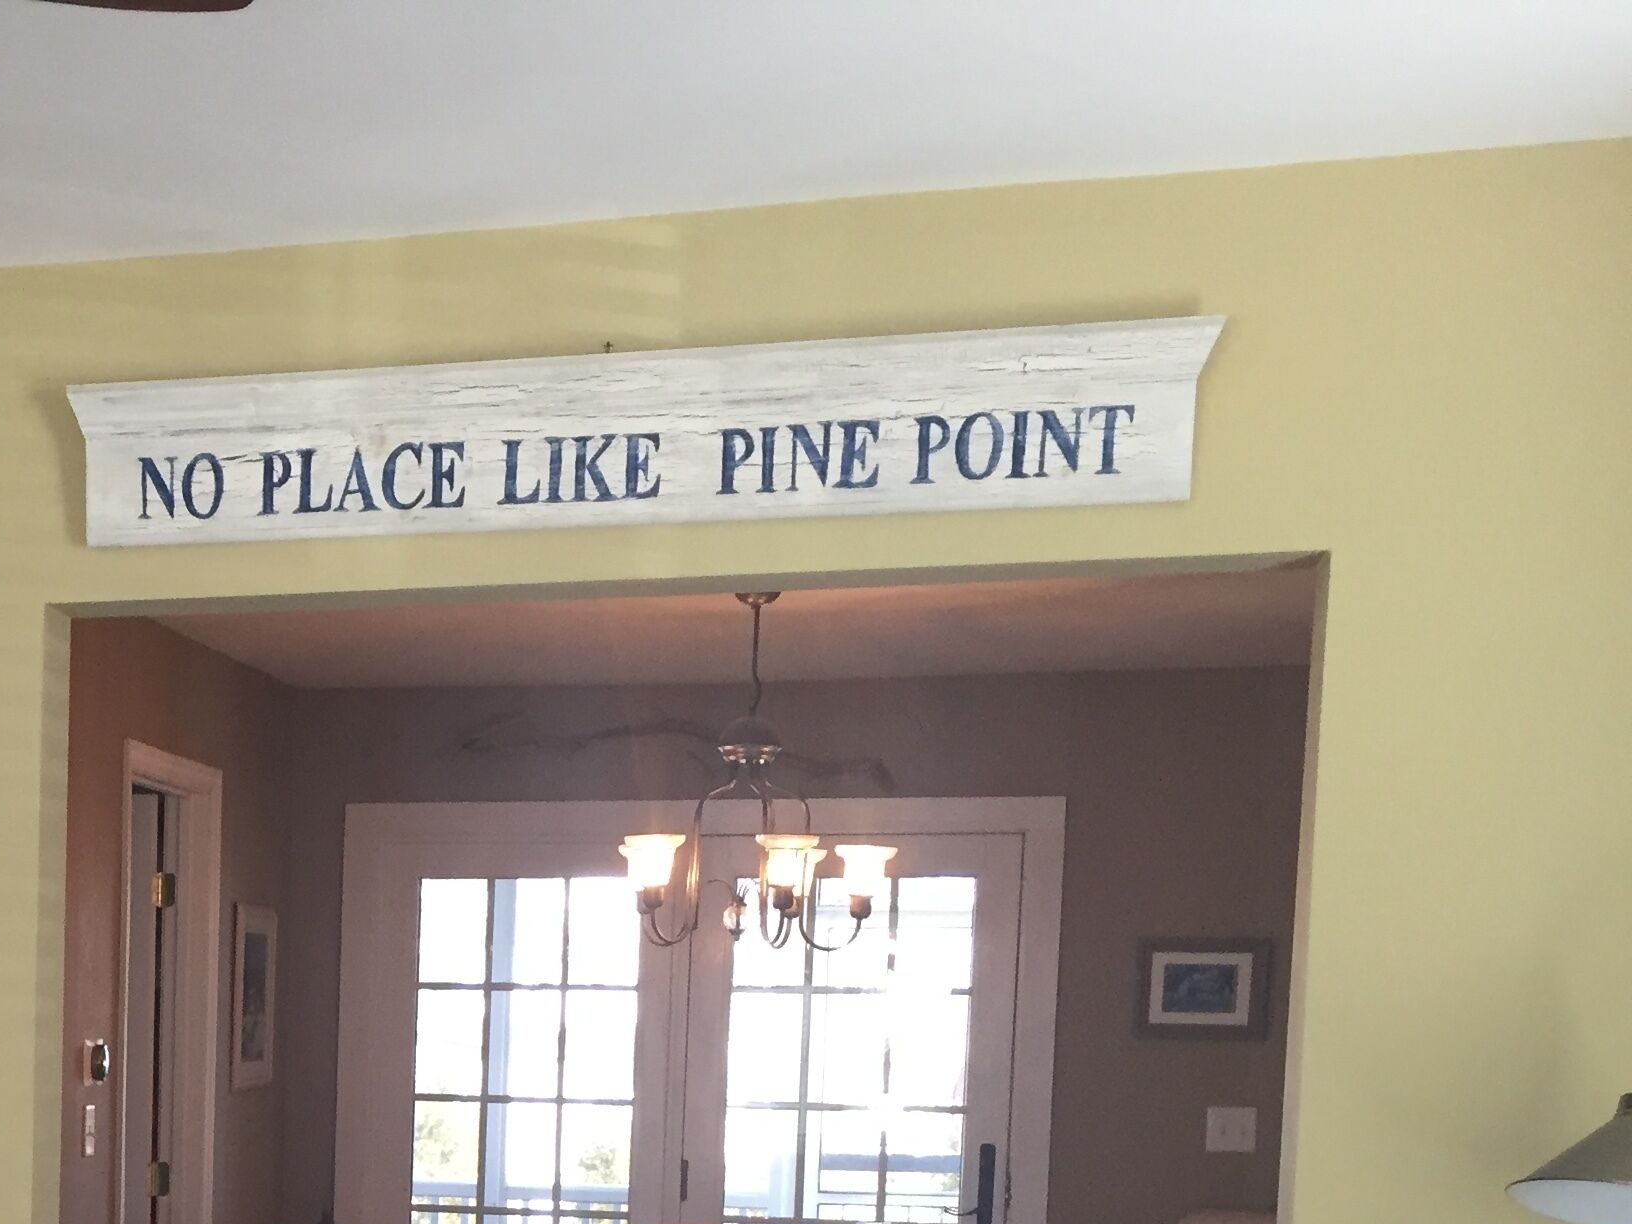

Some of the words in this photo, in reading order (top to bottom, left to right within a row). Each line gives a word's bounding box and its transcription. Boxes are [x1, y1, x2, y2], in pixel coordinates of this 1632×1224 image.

[137, 451, 226, 520] NO
[257, 441, 466, 516] PLACE
[497, 432, 661, 506] LIKE
[715, 419, 881, 495] PINE
[909, 403, 1136, 485] POINT
